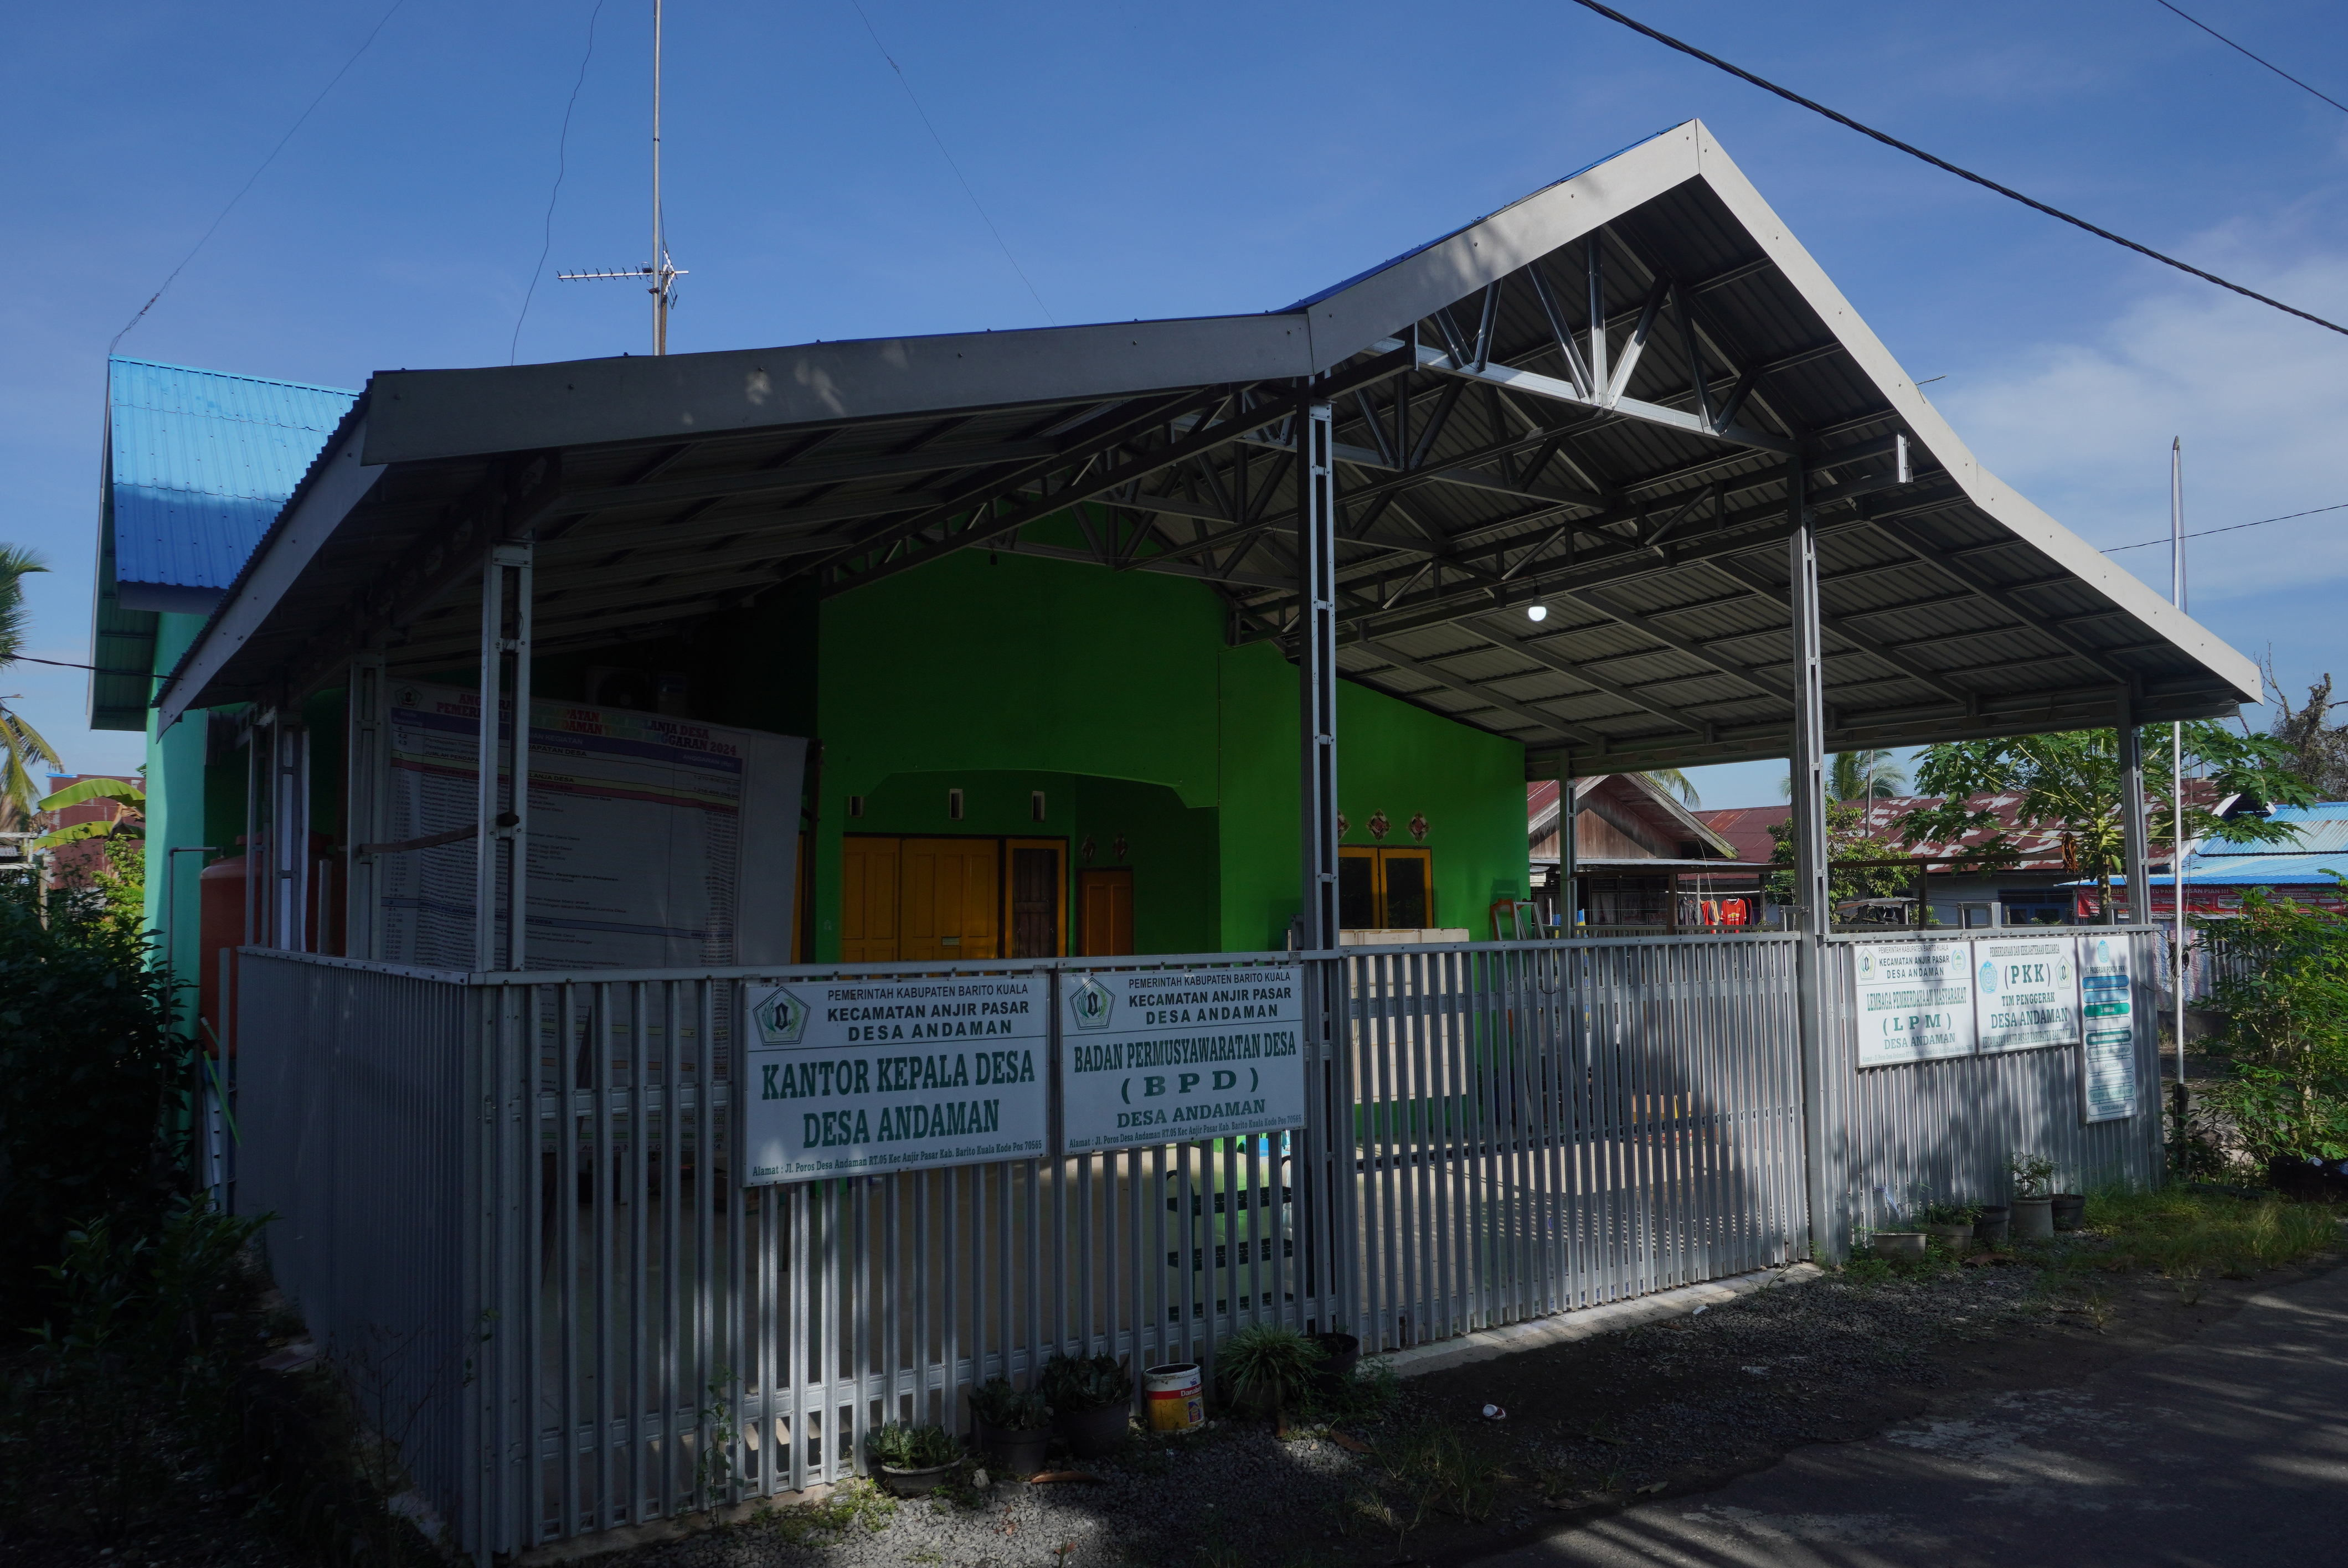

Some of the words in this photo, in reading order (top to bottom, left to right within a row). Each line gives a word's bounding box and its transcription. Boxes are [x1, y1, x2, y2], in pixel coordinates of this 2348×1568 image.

[680, 725, 709, 740] DESA
[710, 741, 737, 756] 2024
[1878, 946, 1902, 954] PEMERINTAH
[1902, 945, 1923, 953] KABUPATEN
[1879, 957, 1913, 967] KECAMATAN
[1914, 956, 1931, 964] ANJIR
[1932, 955, 1950, 963] PASAR
[1129, 977, 1182, 989] PEMERINTAH
[1184, 974, 1232, 986] KABUPATEN
[1234, 973, 1263, 983] BARITO
[1265, 972, 1290, 982] KUALA
[1887, 969, 1906, 979] DESA
[1908, 967, 1944, 977] ANDAMAN
[828, 988, 893, 1000] PEMERINTAH
[897, 986, 955, 998] KABUPATEN
[959, 985, 993, 997] BARITO
[997, 984, 1028, 994] KUALA
[1129, 992, 1208, 1007] KECAMATAN
[1212, 989, 1249, 1003] ANJIR
[1253, 987, 1291, 1000] PASAR
[1867, 992, 1892, 1011] LEMBAGA
[1893, 989, 1933, 1009] PEMBERDAYAAN
[1934, 987, 1966, 1006] MASYARAKAT
[2001, 995, 2014, 1007] TIM
[2016, 992, 2055, 1005] PENGGERAK
[828, 1005, 925, 1022] KECAMATAN
[931, 1003, 976, 1017] ANJIR
[982, 1001, 1029, 1015] PASAR
[1146, 1009, 1191, 1024] DESA
[1197, 1004, 1278, 1022] ANDAMAN
[1991, 1012, 2017, 1029] DESA
[2020, 1008, 2067, 1026] ANDAMAN
[848, 1025, 903, 1041] DESA
[912, 1020, 1011, 1038] ANDAMAN
[2006, 1033, 2017, 1045] ANJIR
[2018, 1033, 2030, 1044] PASAR
[2030, 1030, 2051, 1043] KABUPATEN
[2052, 1029, 2065, 1041] BARITO
[1884, 1038, 1908, 1050] DESA
[1911, 1033, 1955, 1047] ANDAMAN
[1074, 1043, 1122, 1073] BADAN
[1127, 1034, 1260, 1069] PERMUSYAWARATAN
[1264, 1031, 1296, 1057] DESA
[762, 1059, 870, 1101] KANTOR
[877, 1054, 969, 1092] KEPALA
[975, 1050, 1035, 1086] DESA
[1117, 1108, 1167, 1128] DESA
[1172, 1099, 1265, 1122] ANDAMAN
[803, 1110, 870, 1148] DESA
[877, 1100, 1000, 1142] ANDAMAN
[1069, 1138, 1090, 1148] Alamat
[1104, 1136, 1119, 1144] Poros
[1120, 1134, 1133, 1142] Desa
[1135, 1132, 1161, 1141] Andaman
[1162, 1129, 1176, 1138] RT.05
[1177, 1127, 1187, 1136] Kec
[1189, 1126, 1202, 1136] Anjir
[1203, 1125, 1218, 1133] Pasar
[1232, 1121, 1247, 1130] Barito
[1249, 1119, 1263, 1128] Kuala
[1265, 1117, 1277, 1126] Kode
[1278, 1117, 1286, 1125] Pos
[753, 1165, 779, 1177] Alamat
[796, 1163, 815, 1172] Poros
[816, 1161, 832, 1170] Desa
[835, 1158, 867, 1169] Andaman
[869, 1154, 887, 1165] RT.05
[889, 1154, 901, 1163] Kec
[903, 1152, 919, 1164] Anjir
[921, 1151, 938, 1160] Pasar
[956, 1146, 975, 1157] Barito
[977, 1144, 995, 1154] Kuala
[996, 1142, 1011, 1153] Kode
[1013, 1142, 1023, 1151] Pos
[1024, 1140, 1042, 1151] 70565
